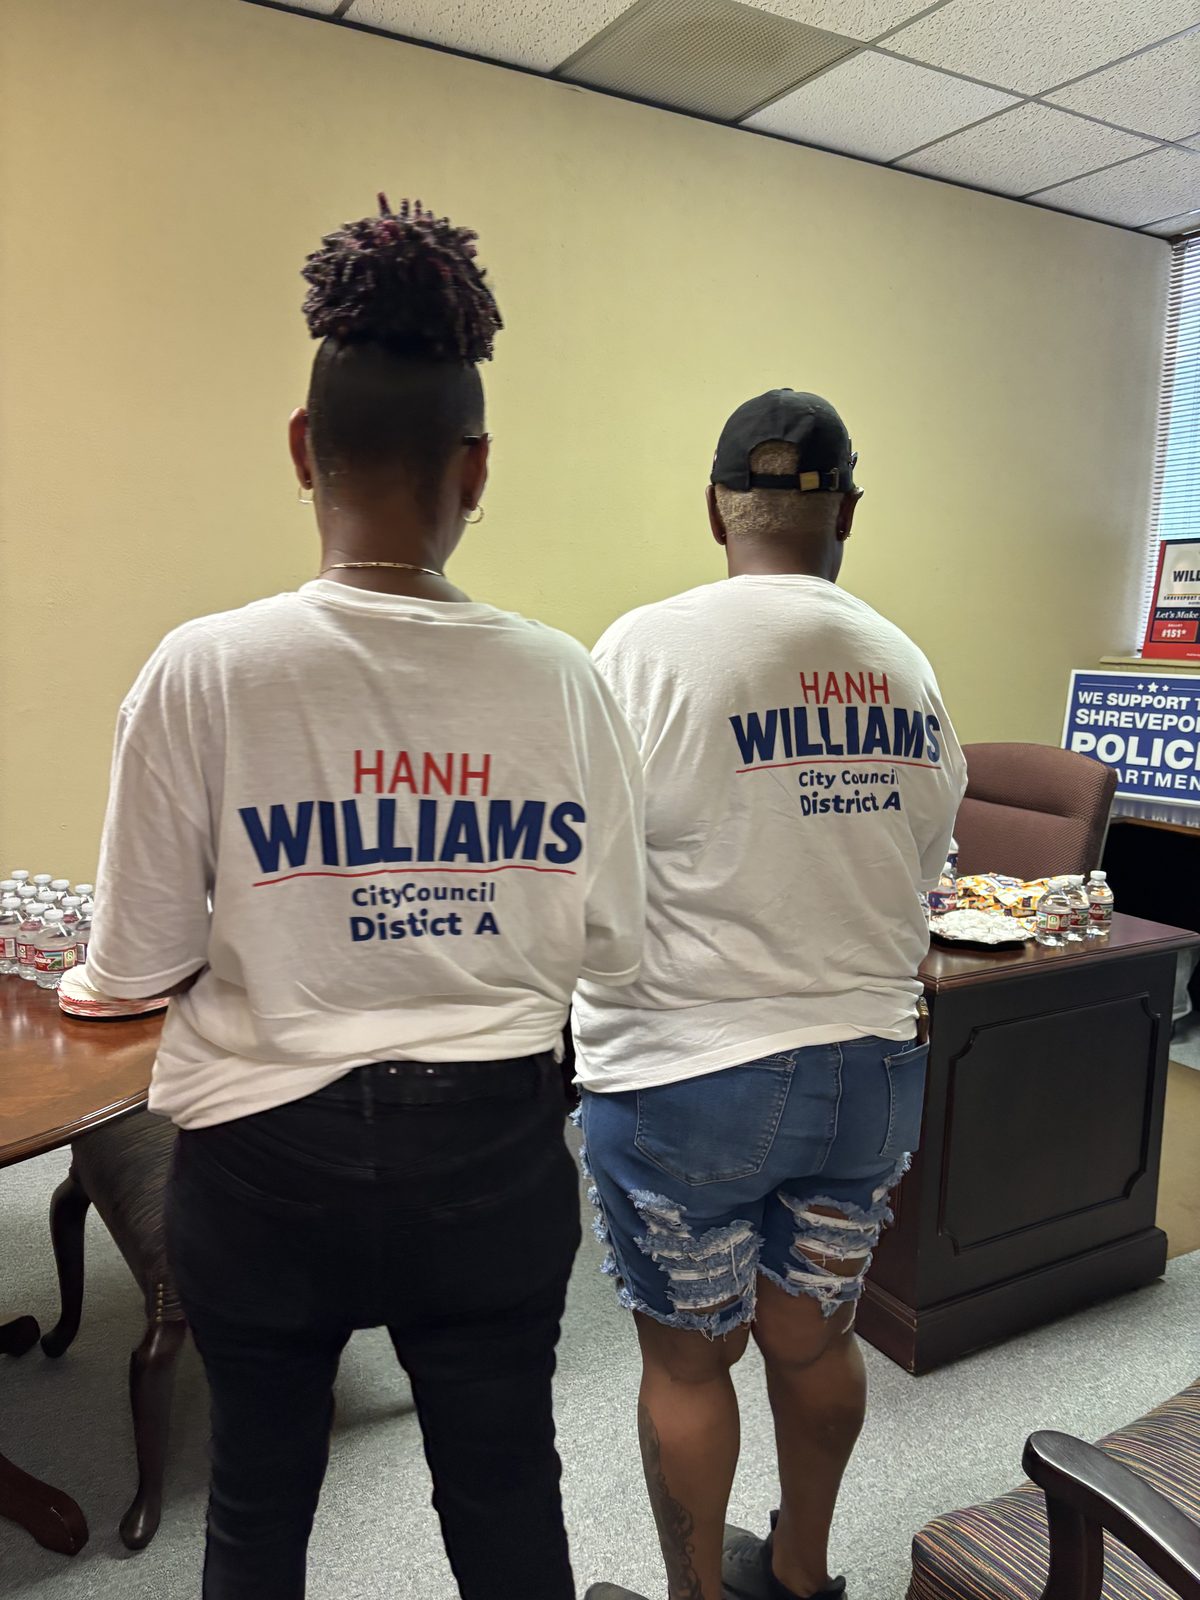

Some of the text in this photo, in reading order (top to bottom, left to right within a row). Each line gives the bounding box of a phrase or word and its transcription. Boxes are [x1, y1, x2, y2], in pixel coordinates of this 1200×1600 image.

[1156, 611, 1198, 619] Let's Make
[799, 671, 891, 705] HANH
[1078, 691, 1103, 705] WE
[1106, 693, 1191, 711] SUPPORT
[728, 705, 941, 765] WILLIAMS
[354, 749, 491, 797] HANH
[798, 769, 837, 789] City
[1115, 768, 1200, 791] ARTMEN
[800, 790, 901, 817] District A
[237, 798, 586, 874] WILLIAMS
[473, 911, 501, 935] A
